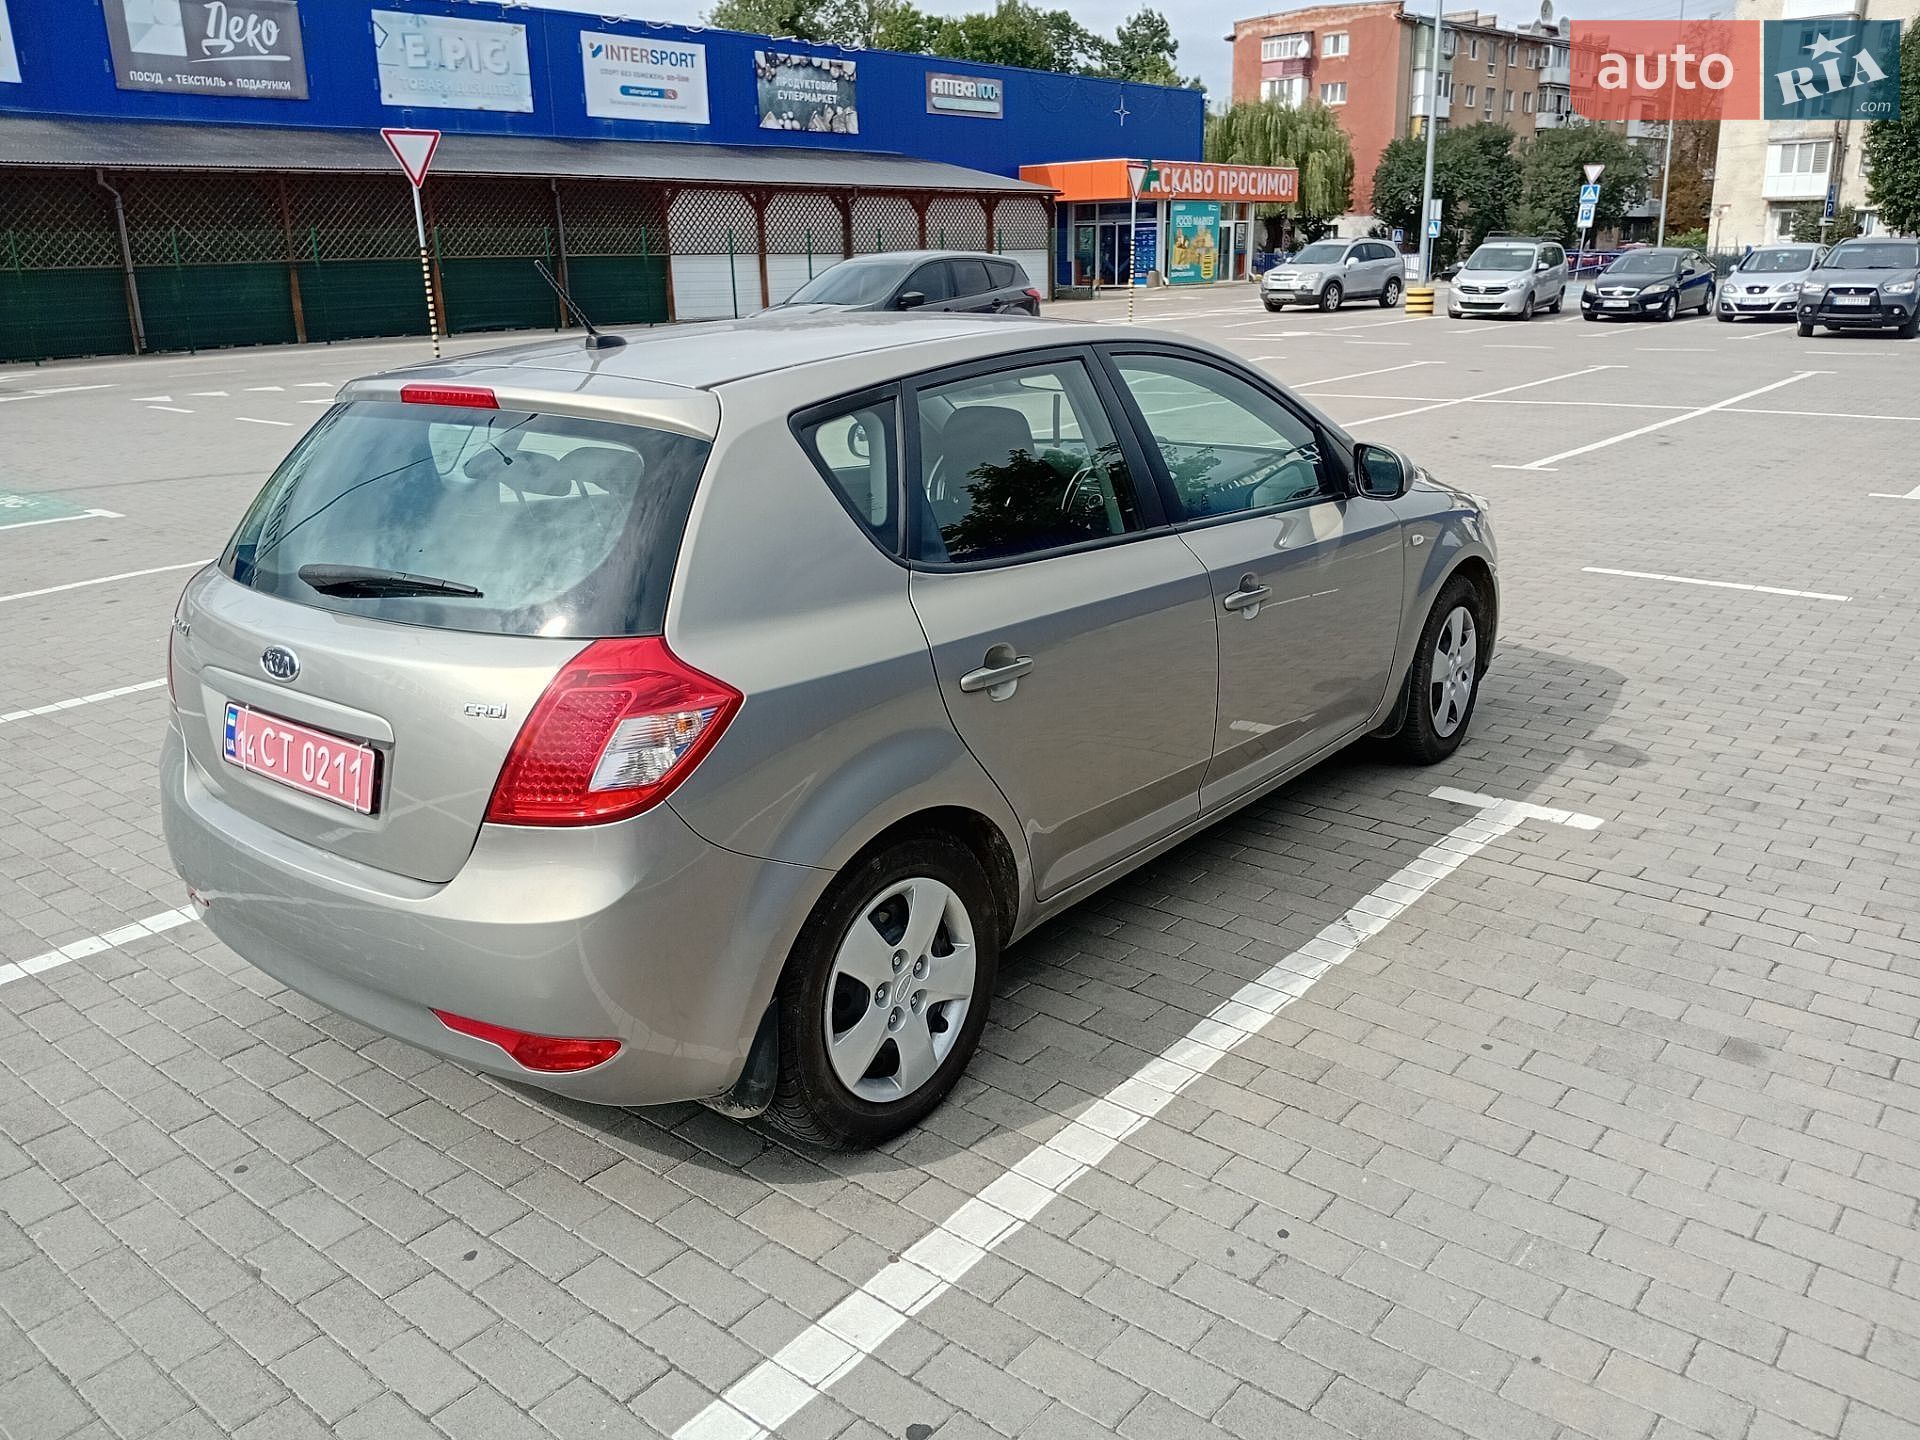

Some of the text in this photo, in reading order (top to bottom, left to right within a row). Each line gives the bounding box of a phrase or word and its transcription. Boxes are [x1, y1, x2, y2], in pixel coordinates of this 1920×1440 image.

[201, 1, 281, 56] Деко
[605, 43, 696, 69] INTERSPORT
[129, 70, 292, 91] ПОСУД ТЕКСТИЛЬ ПОДАРУНКИ
[776, 76, 838, 92] ПРОДУКТОВИЙ
[777, 89, 838, 105] СУПЕРМАРКЕТ
[1149, 167, 1293, 196] АСКАВО ПРОСИМО!
[267, 648, 292, 676] KIA
[226, 737, 236, 752] UA
[302, 740, 364, 801] 0211
